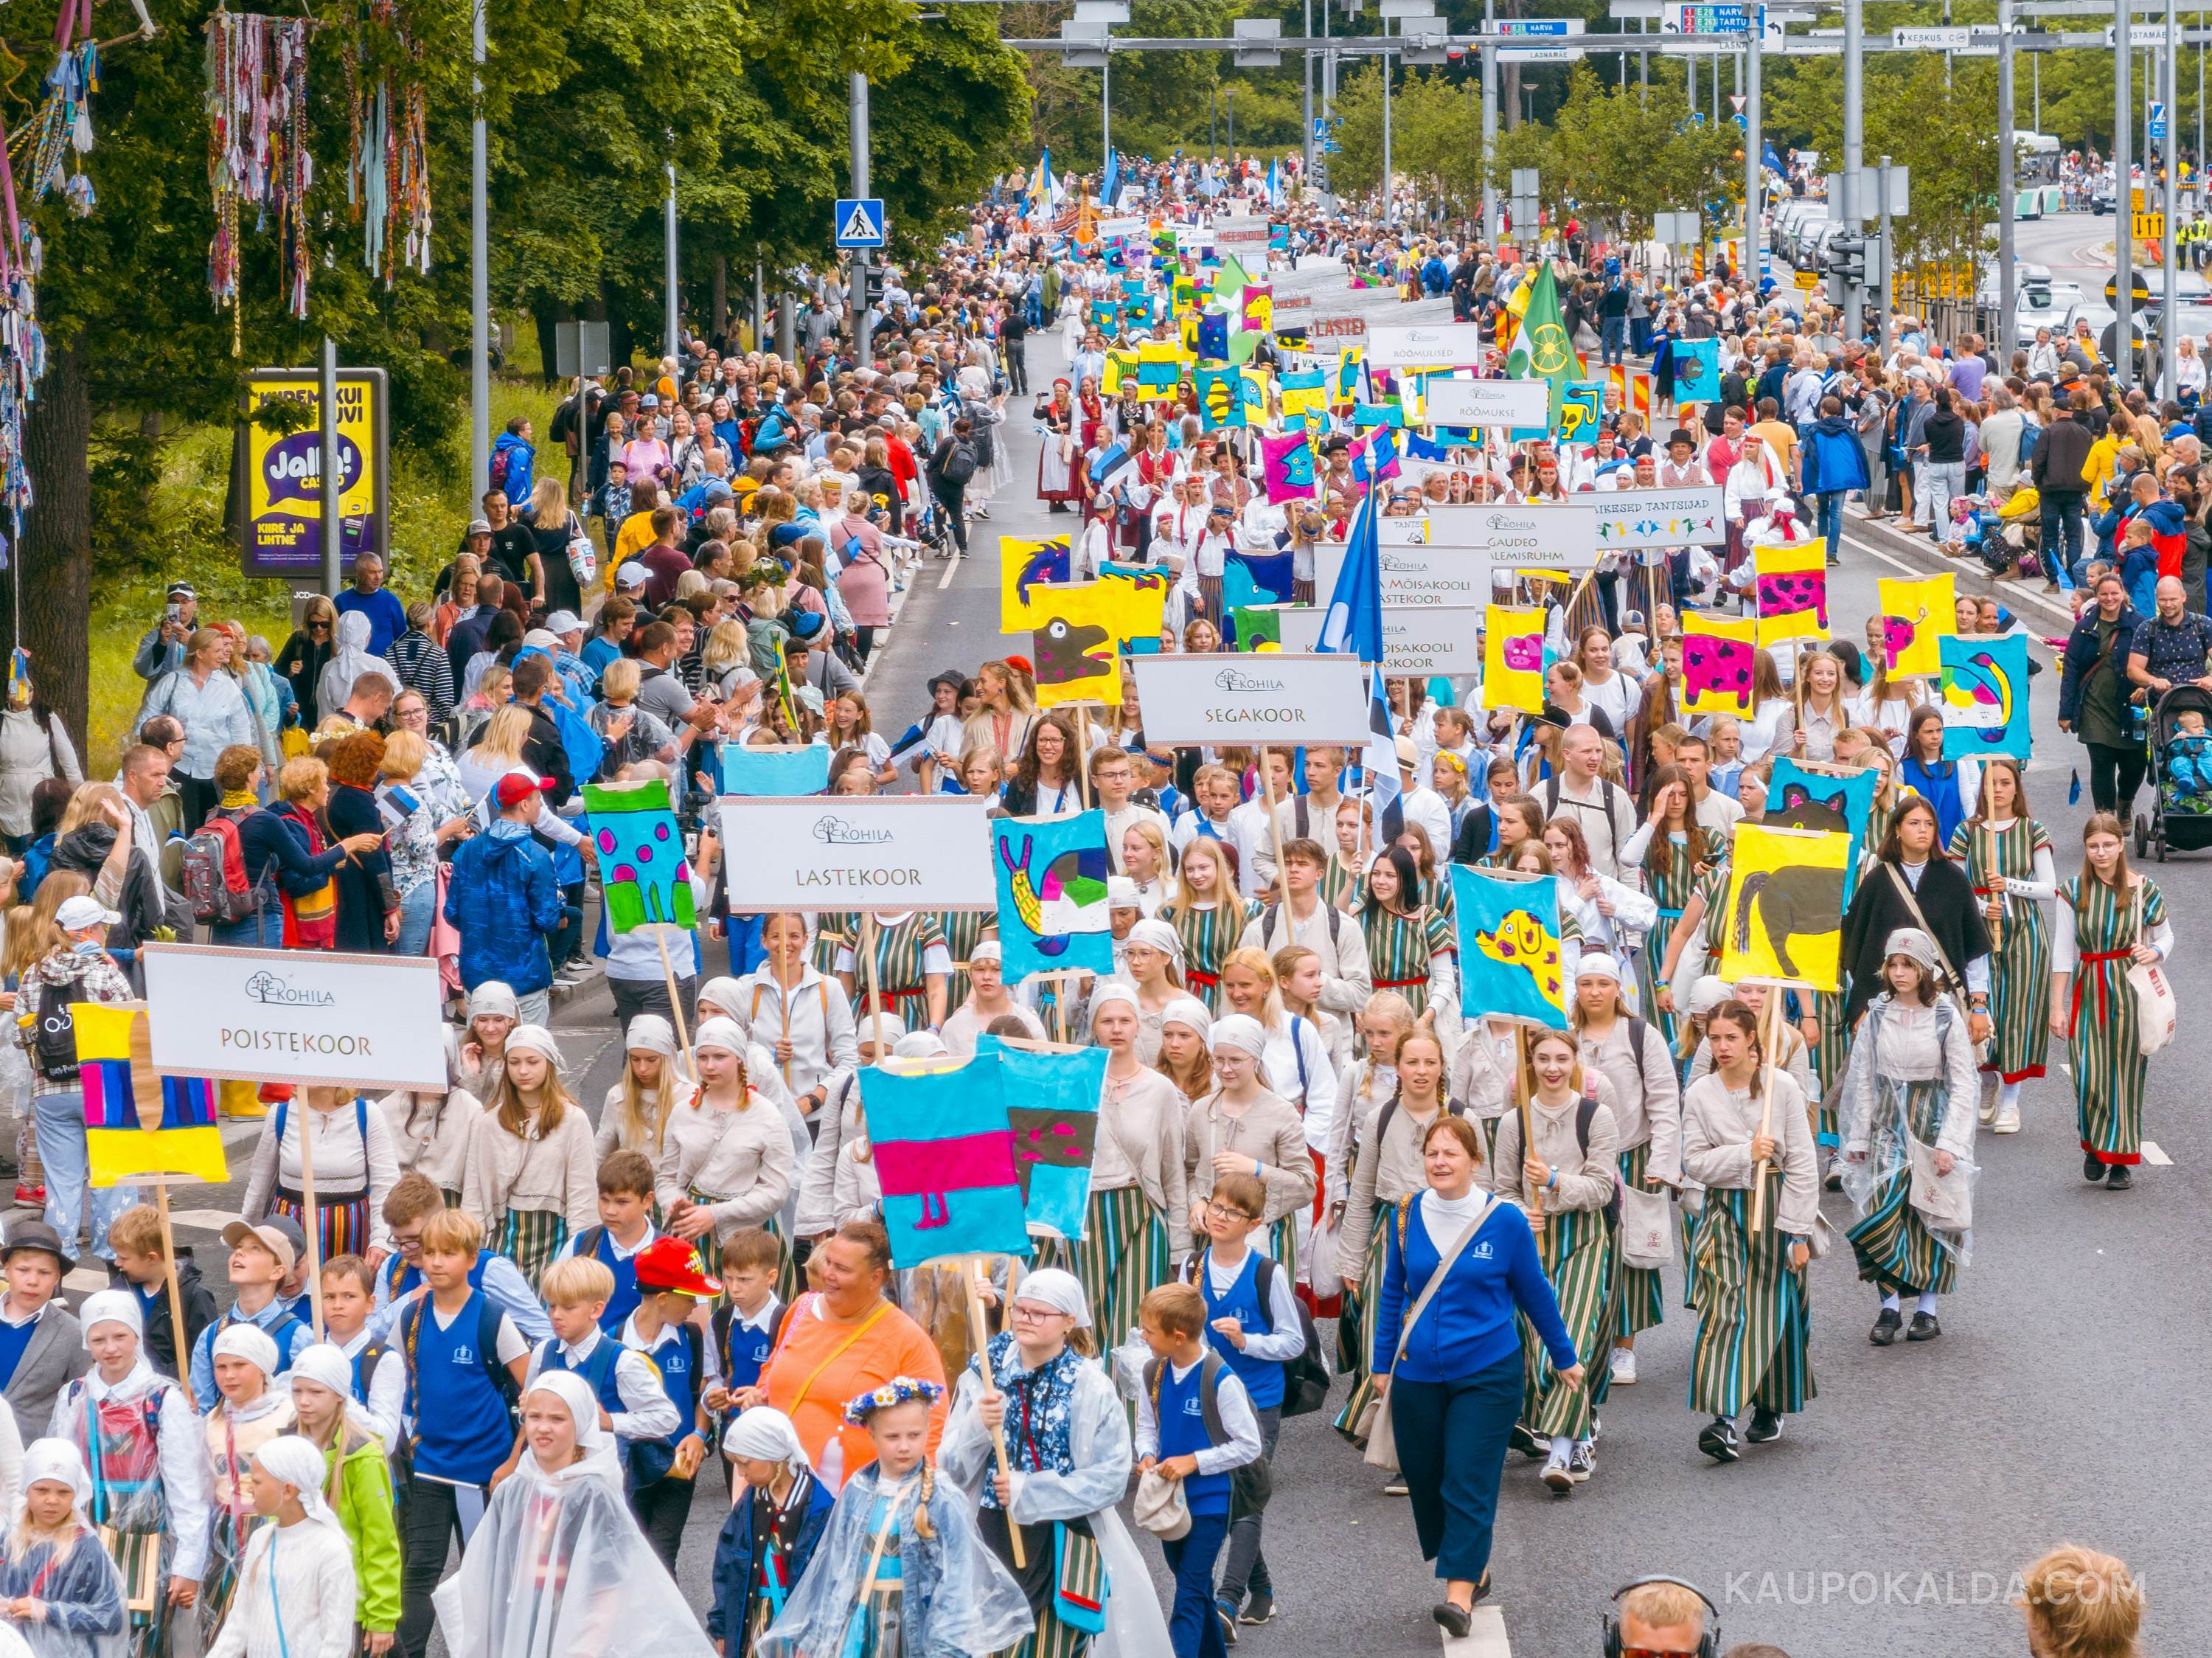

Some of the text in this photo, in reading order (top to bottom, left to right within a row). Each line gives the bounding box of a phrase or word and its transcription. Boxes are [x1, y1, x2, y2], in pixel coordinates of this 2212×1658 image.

[1595, 499, 1710, 514] IKESED TANTSIJAD
[258, 522, 305, 534] KIIRE JA
[257, 534, 296, 546] LIHTNE
[1487, 537, 1538, 547] GAUDEO
[1394, 562, 1428, 570] KOHILA
[1389, 578, 1470, 591] MÕISAKOOLI
[1380, 594, 1442, 604] ASTEKOOR
[1382, 642, 1453, 653] ÕISAKOOLI
[1239, 679, 1285, 689] KOHILA
[1206, 707, 1306, 723] SEGAKOOR
[841, 829, 894, 841] KOHILA
[796, 868, 922, 887] LASTEKOOR
[276, 988, 336, 1004] KOHILA
[221, 1027, 372, 1056] POISTEKOOR
